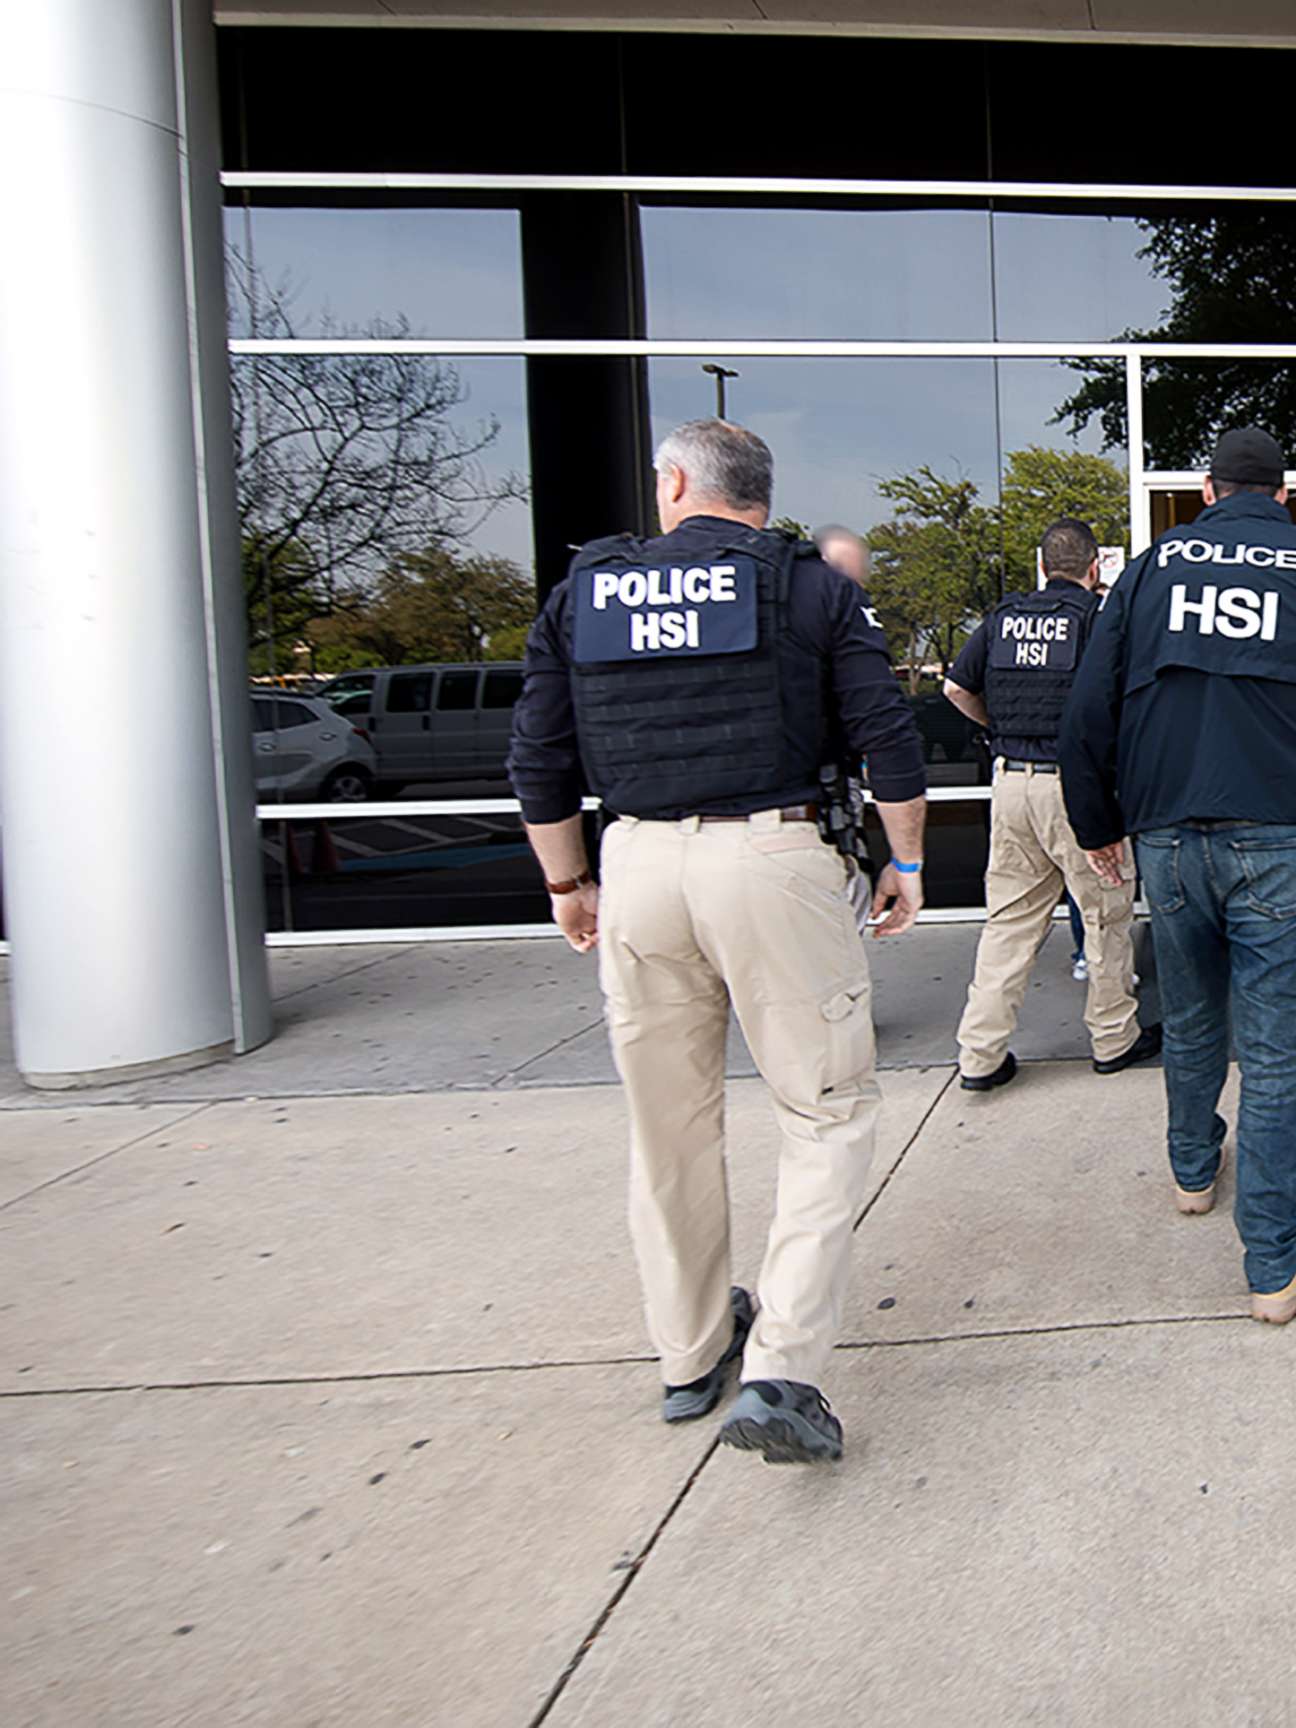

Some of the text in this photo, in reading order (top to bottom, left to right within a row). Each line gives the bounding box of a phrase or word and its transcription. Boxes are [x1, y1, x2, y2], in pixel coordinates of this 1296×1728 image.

[593, 565, 736, 609] POLICE
[631, 610, 699, 651] HSI
[1001, 616, 1069, 641] POLICE
[1168, 584, 1279, 641] HSI
[1015, 642, 1048, 666] HSI
